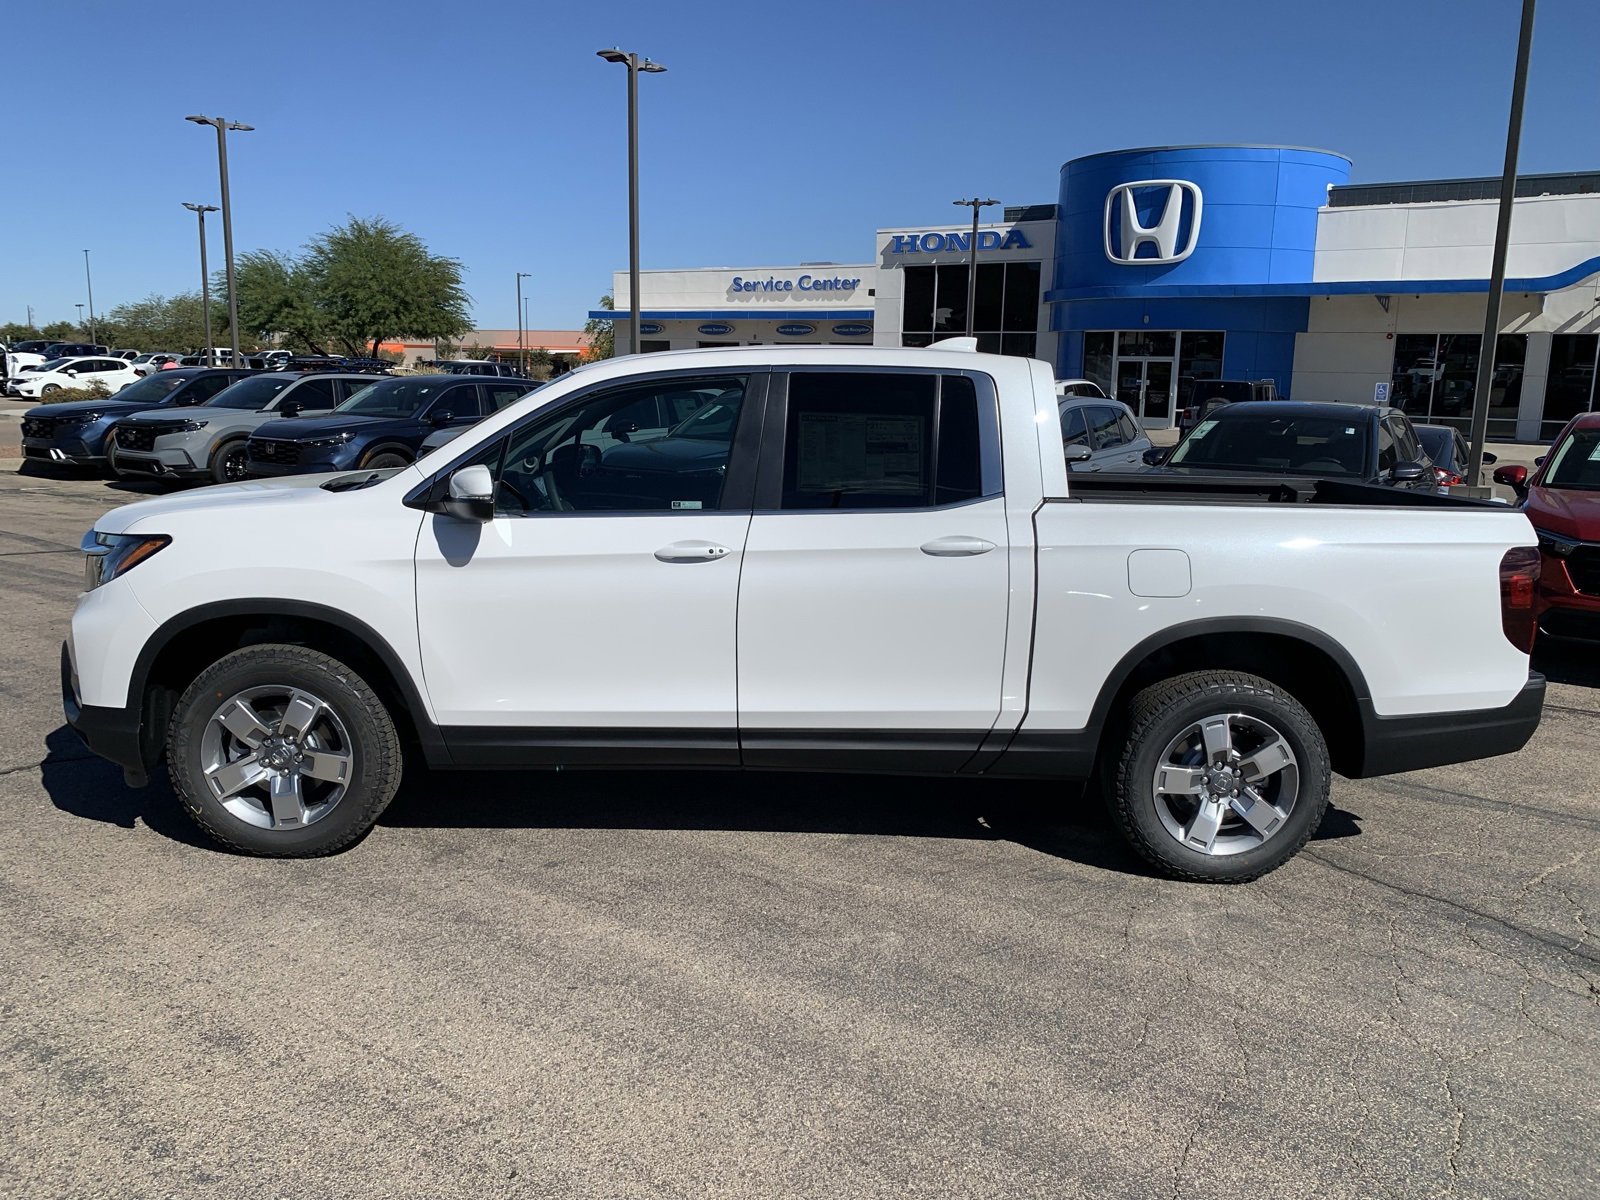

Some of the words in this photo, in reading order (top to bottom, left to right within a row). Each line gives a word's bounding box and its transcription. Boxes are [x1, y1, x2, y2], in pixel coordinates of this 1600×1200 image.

[892, 229, 1032, 254] HONDA
[732, 276, 793, 292] Service
[798, 275, 860, 291] Center
